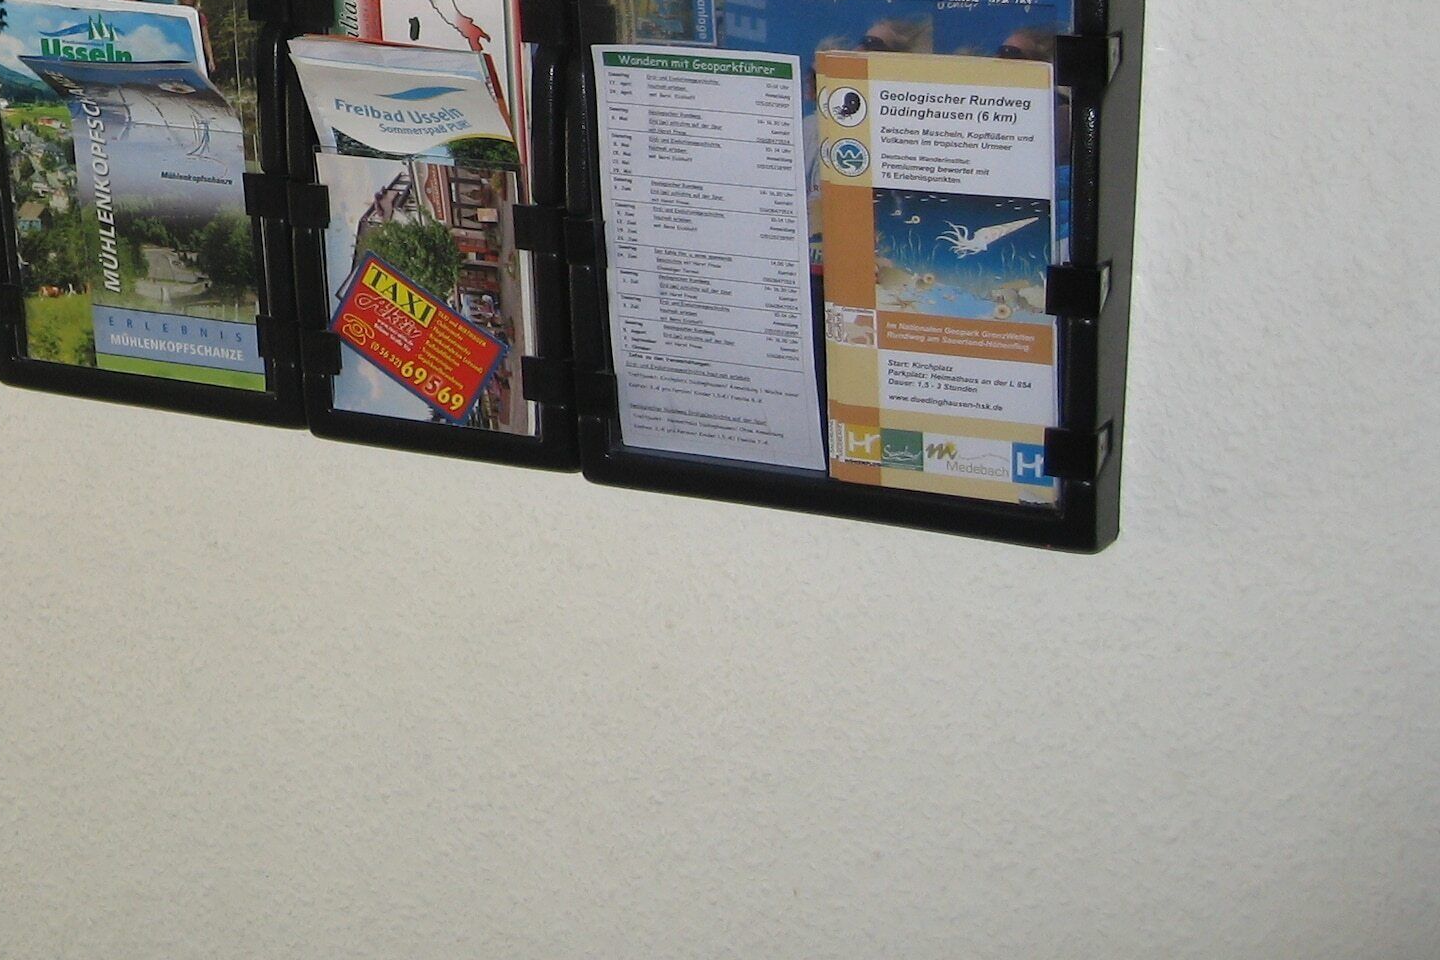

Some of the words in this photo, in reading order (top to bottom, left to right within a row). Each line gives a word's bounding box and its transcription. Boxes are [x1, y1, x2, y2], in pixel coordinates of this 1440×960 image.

[41, 38, 132, 62] Usseln
[618, 54, 669, 68] Wandern
[671, 58, 689, 69] mit
[692, 59, 776, 76] Geoparkführer
[879, 90, 963, 105] Geologischer
[969, 95, 1031, 110] Rundweg
[335, 98, 404, 124] Freibad
[408, 104, 464, 125] Usseln
[880, 105, 973, 122] Düdinghausen
[977, 110, 989, 123] (6
[993, 111, 1017, 124] km)
[379, 123, 447, 136] Sommerspaß
[880, 126, 919, 136] Zwischen
[922, 129, 964, 138] Muscheln,
[967, 131, 1014, 142] Kopffüßern
[1017, 134, 1034, 142] und
[880, 136, 919, 145] Vulkanen
[934, 139, 978, 150] tropischen
[981, 142, 1012, 151] Urmeer
[881, 162, 935, 174] Premiumweg
[937, 166, 974, 176] bewertet
[975, 168, 990, 176] mit
[894, 172, 960, 184] Erlebnispunkten
[160, 171, 233, 186] Mühlenkopfschanze
[368, 266, 435, 324] TAXI
[109, 315, 243, 343] ERLEBNIS
[110, 334, 245, 362] MÜHLENKOPFSCHANZE
[912, 361, 953, 373] Kirchplatz
[888, 368, 927, 380] Parkplatz:
[930, 372, 979, 385] Heimathaus
[981, 378, 992, 386] an
[993, 378, 1007, 387] der
[944, 383, 978, 393] Stunden
[946, 460, 1009, 477] Medebach
